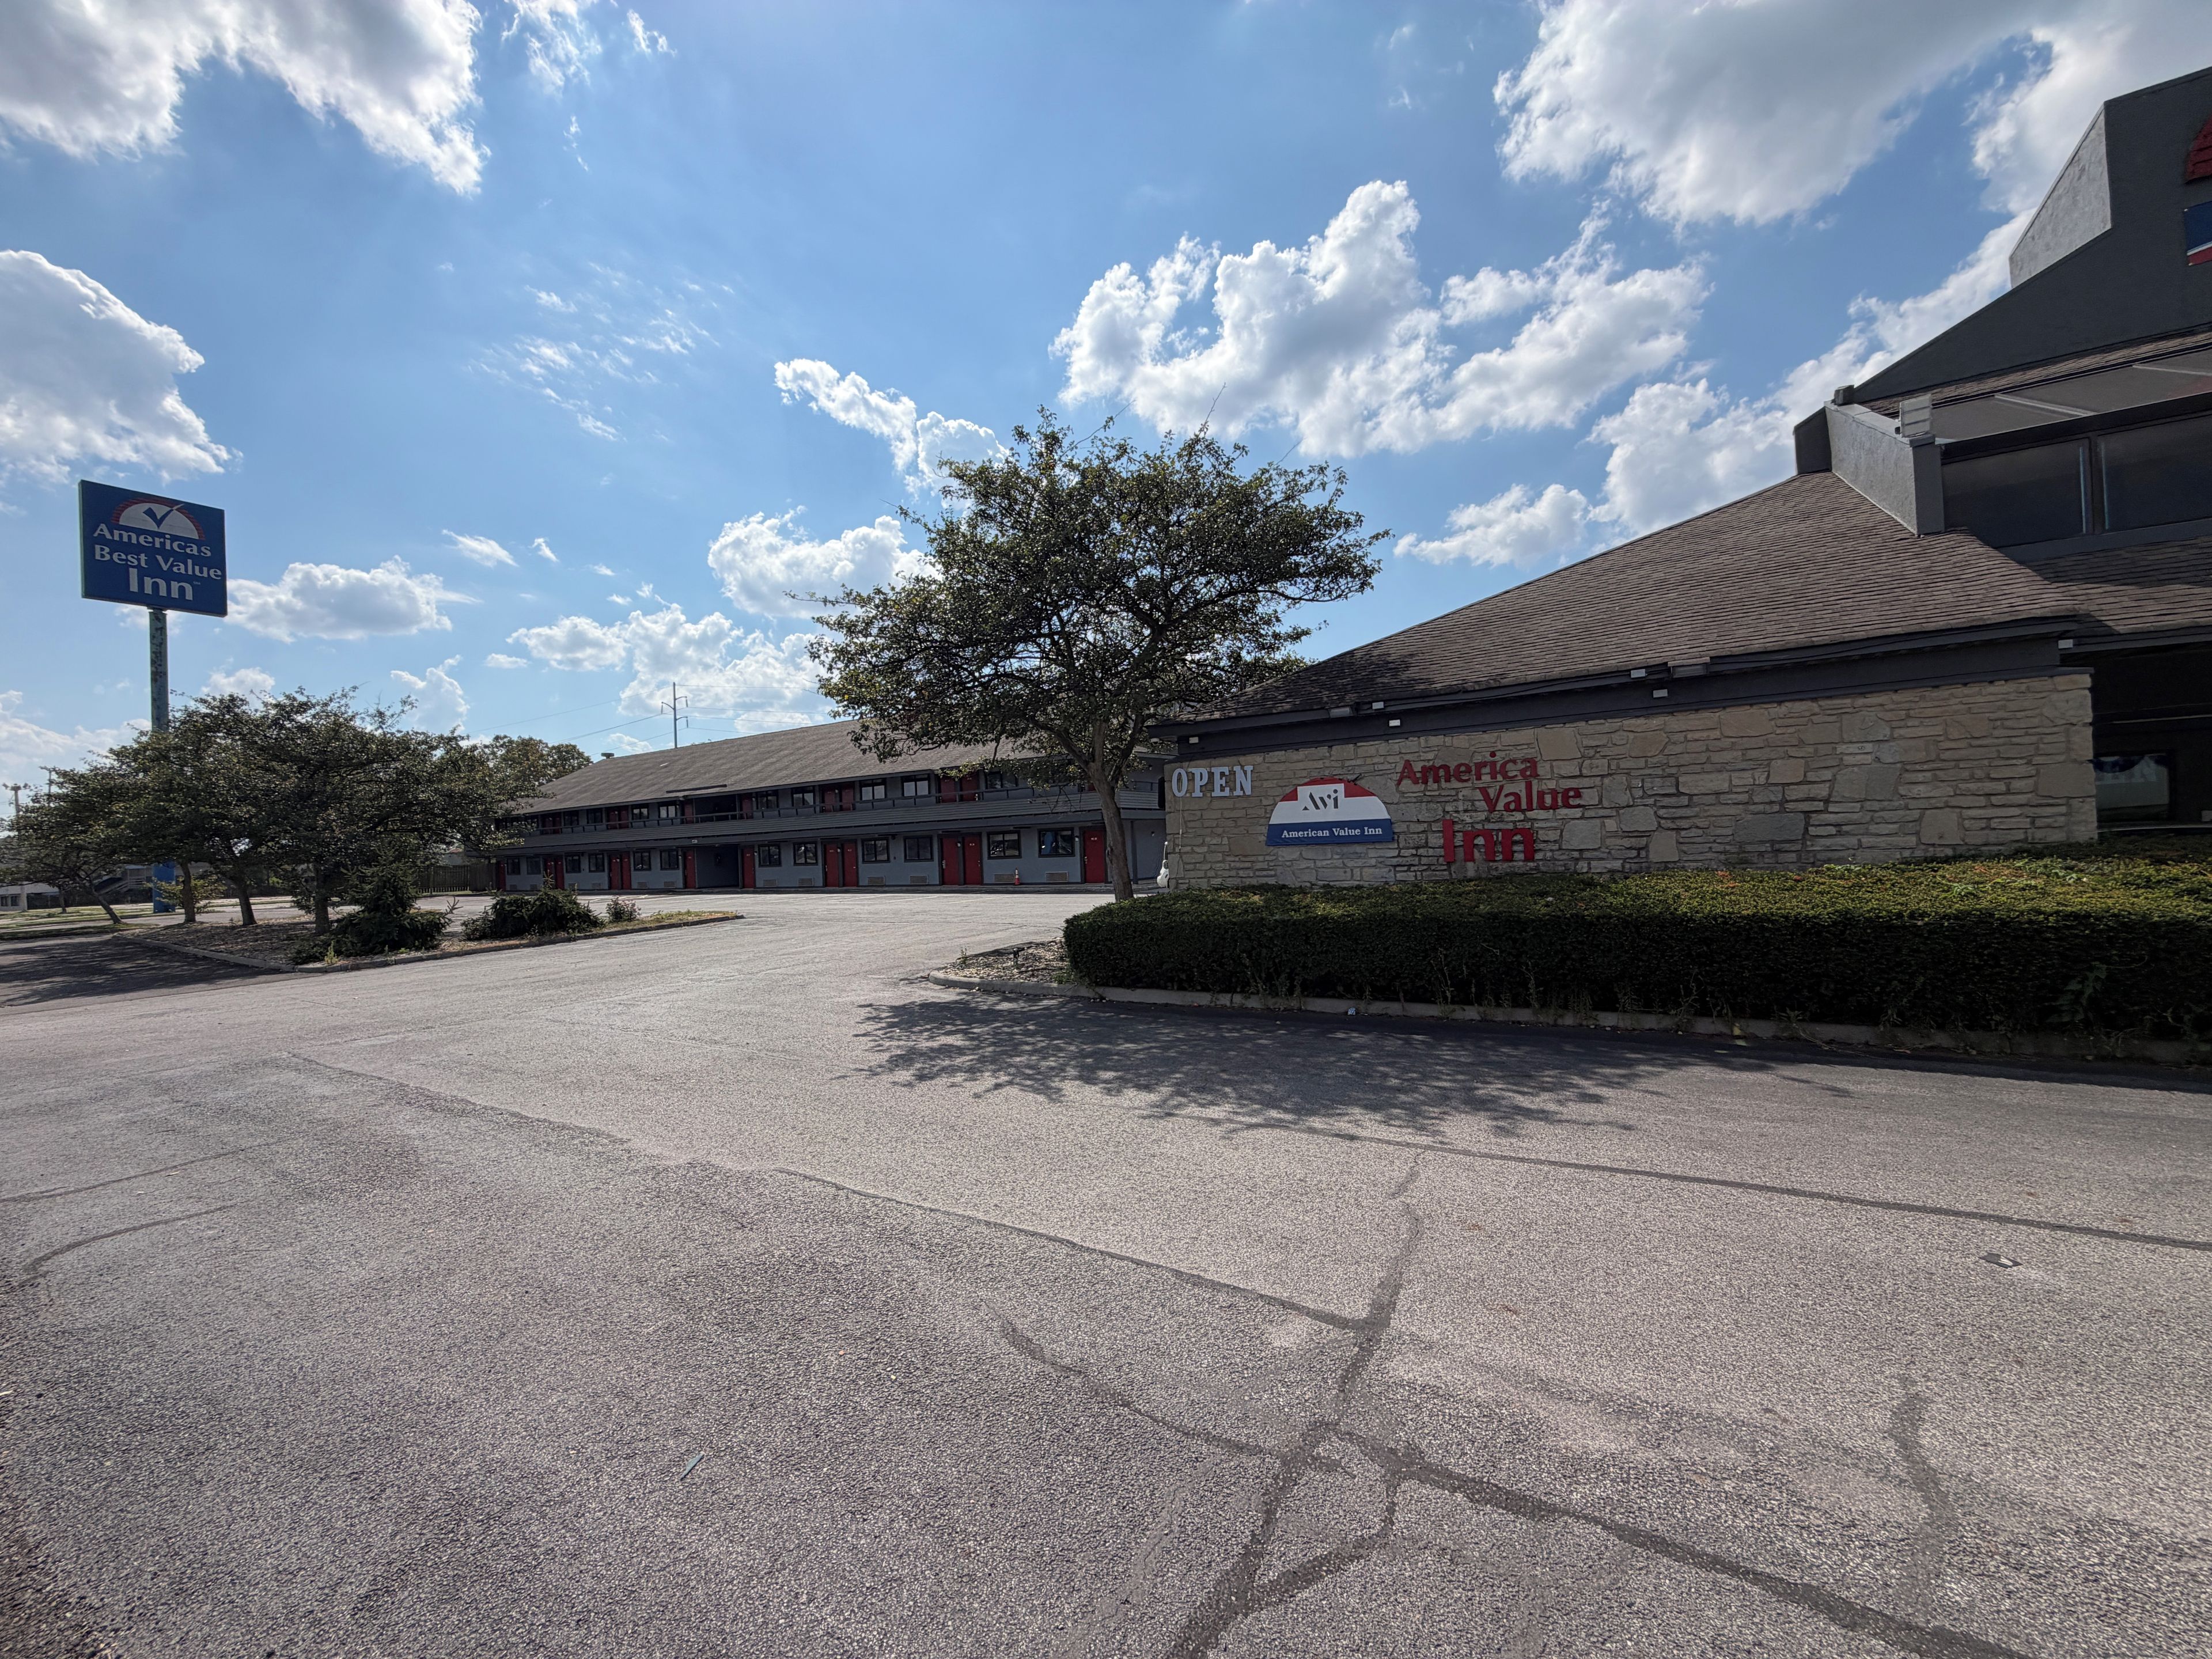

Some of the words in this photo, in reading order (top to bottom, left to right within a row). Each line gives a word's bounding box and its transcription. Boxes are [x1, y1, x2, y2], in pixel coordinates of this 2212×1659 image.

[93, 523, 211, 557] Americas
[94, 544, 149, 568] Best
[155, 555, 222, 580] Value
[128, 568, 193, 600] Inn
[1172, 765, 1253, 797] OPEN
[1396, 751, 1540, 786] America
[1478, 780, 1583, 813] Value
[1281, 829, 1330, 838] American
[1332, 827, 1361, 836] Value
[1364, 827, 1382, 835] Inn
[1442, 819, 1535, 862] Inn
